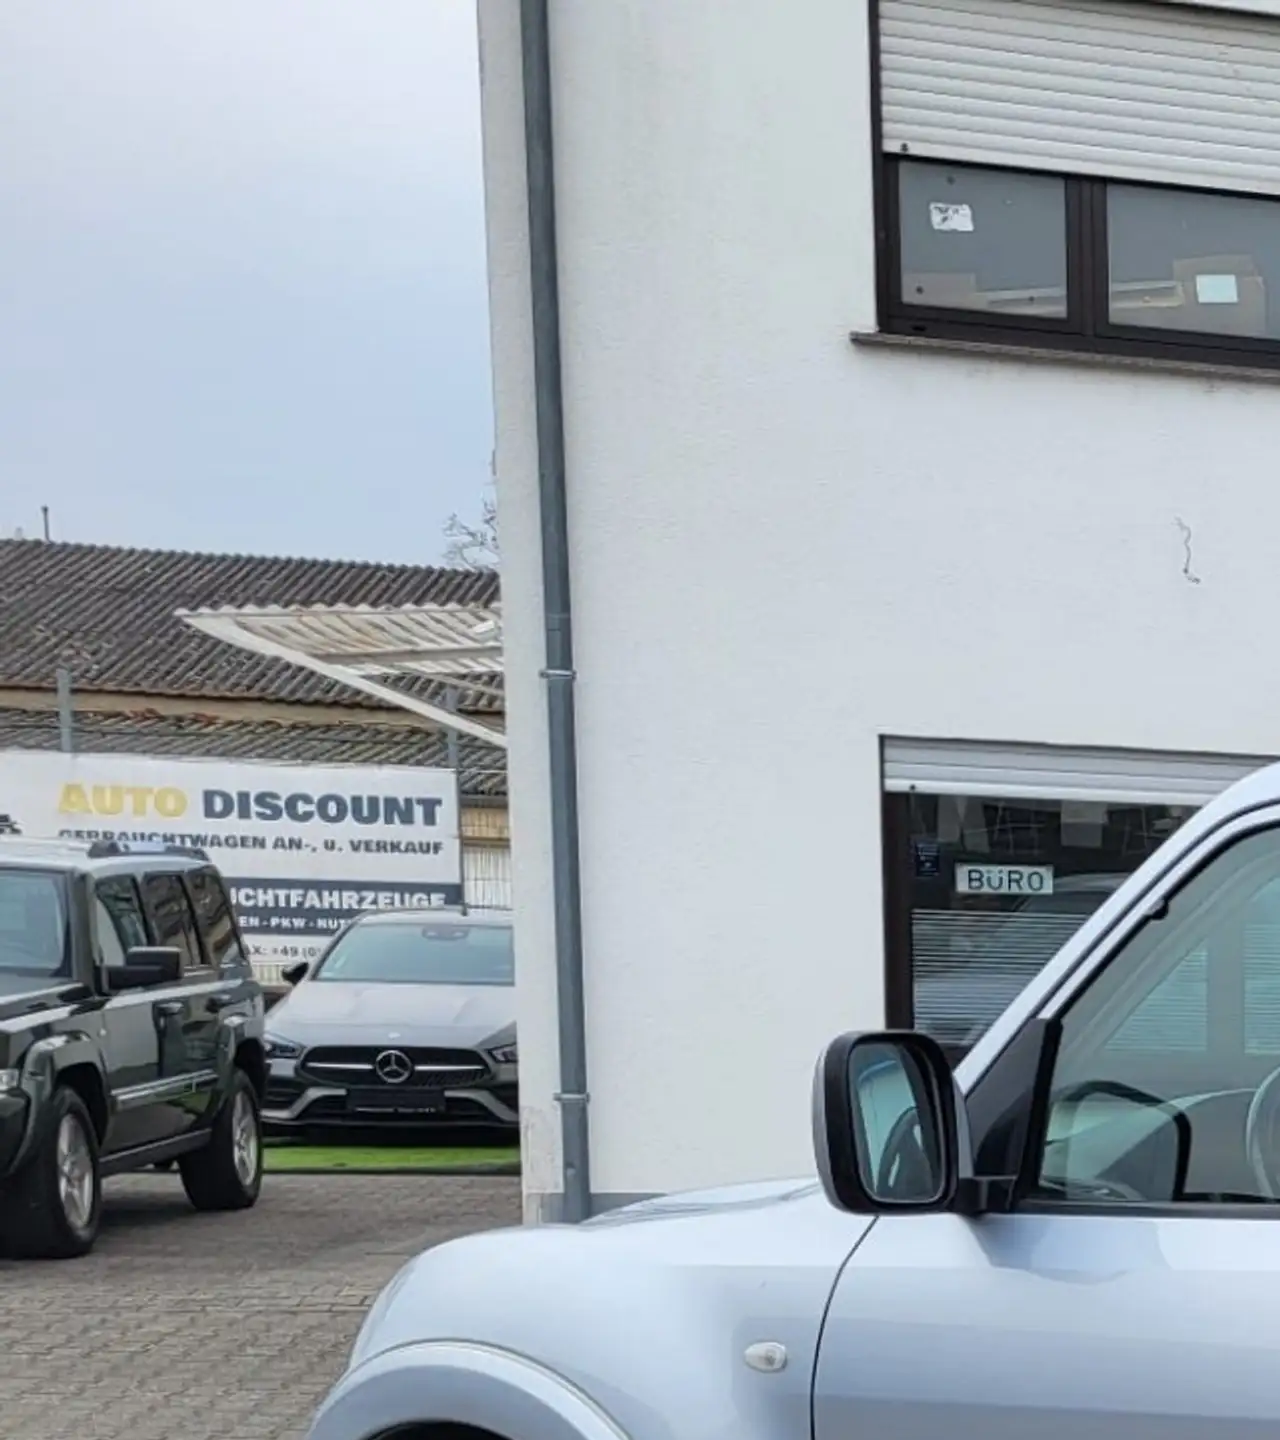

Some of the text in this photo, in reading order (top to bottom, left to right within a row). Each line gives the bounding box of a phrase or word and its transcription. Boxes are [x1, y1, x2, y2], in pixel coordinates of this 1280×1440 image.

[59, 783, 443, 826] AUTO DISCOUNT
[350, 839, 444, 855] VERKAUF
[270, 915, 306, 930] PKW
